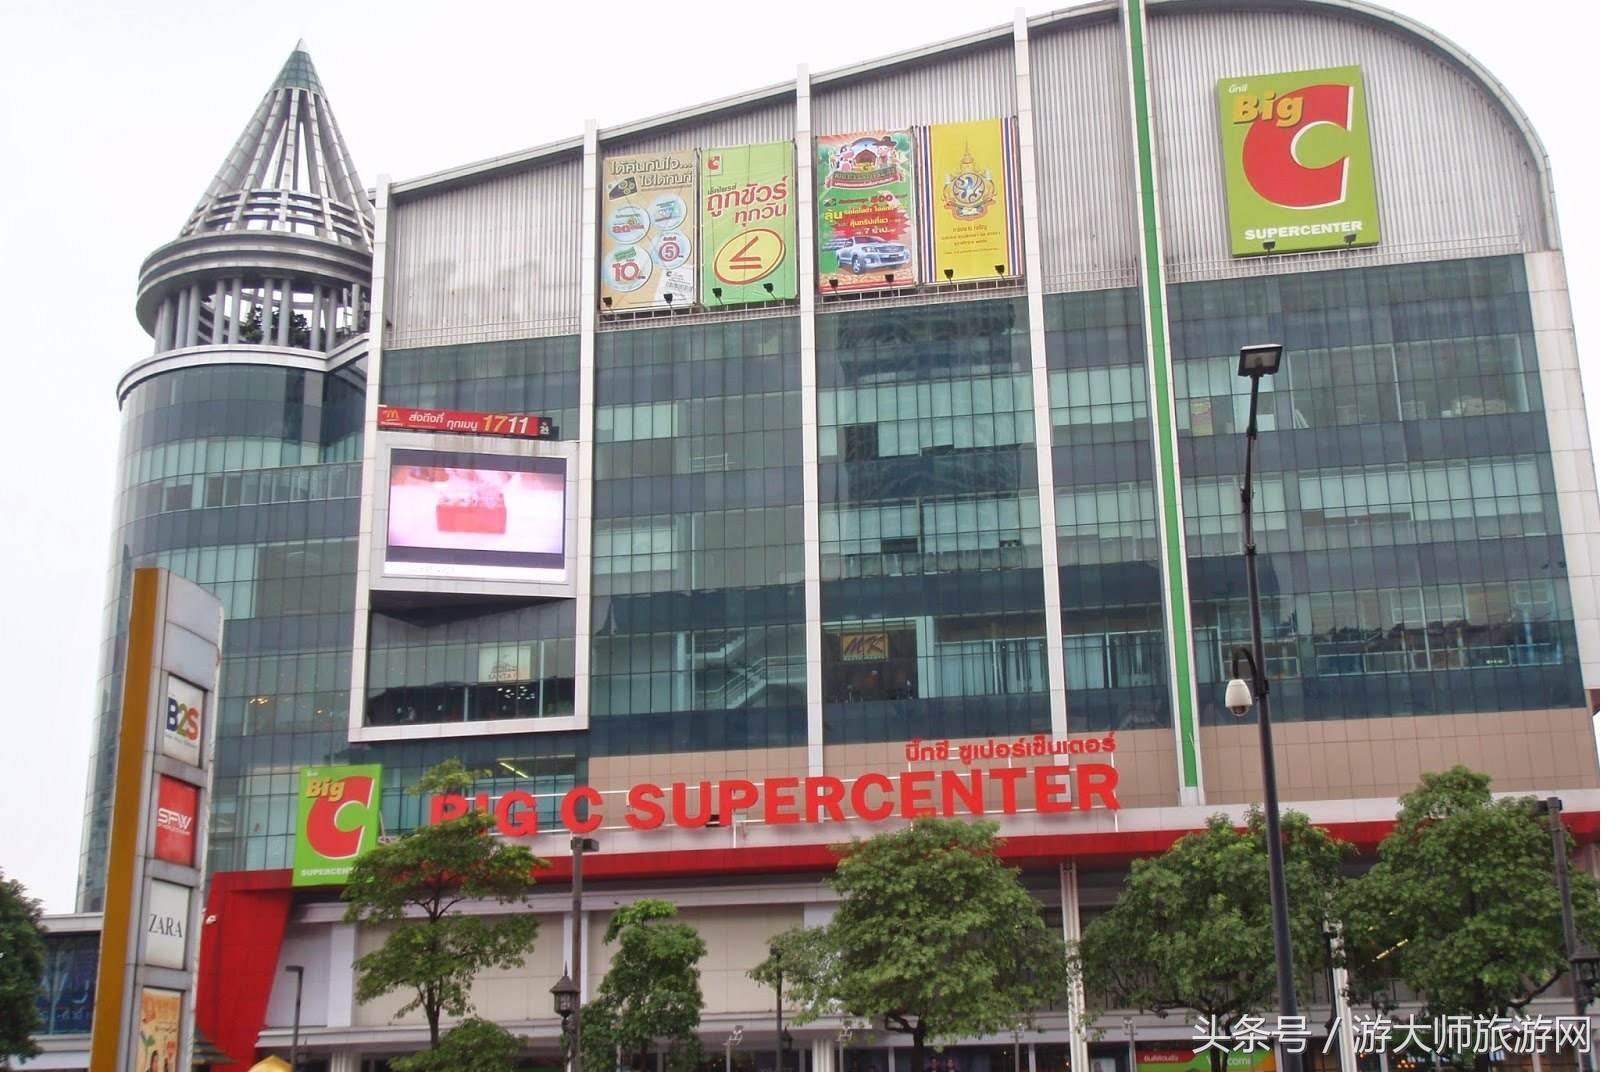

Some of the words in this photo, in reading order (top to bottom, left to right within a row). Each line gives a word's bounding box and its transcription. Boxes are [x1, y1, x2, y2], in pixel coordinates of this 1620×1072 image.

[1232, 91, 1304, 127] Big
[1242, 82, 1354, 210] C
[707, 176, 788, 217] ถูกชัวร์
[735, 203, 787, 227] ทุกวัน
[1244, 220, 1363, 240] SUPERCENTER
[408, 412, 445, 423] ส่งถึงที่
[446, 419, 478, 431] ทุกเมนู
[483, 414, 529, 434] 1711
[167, 697, 199, 740] B2S
[905, 736, 948, 762] บิ๊กซี
[958, 731, 1116, 765] ซูเปอร์เซ็นเตอร์
[305, 777, 345, 802] Big
[560, 786, 604, 833] C
[624, 763, 1121, 831] SUPERCENTER
[306, 774, 375, 860] C
[149, 913, 183, 938] ZARA
